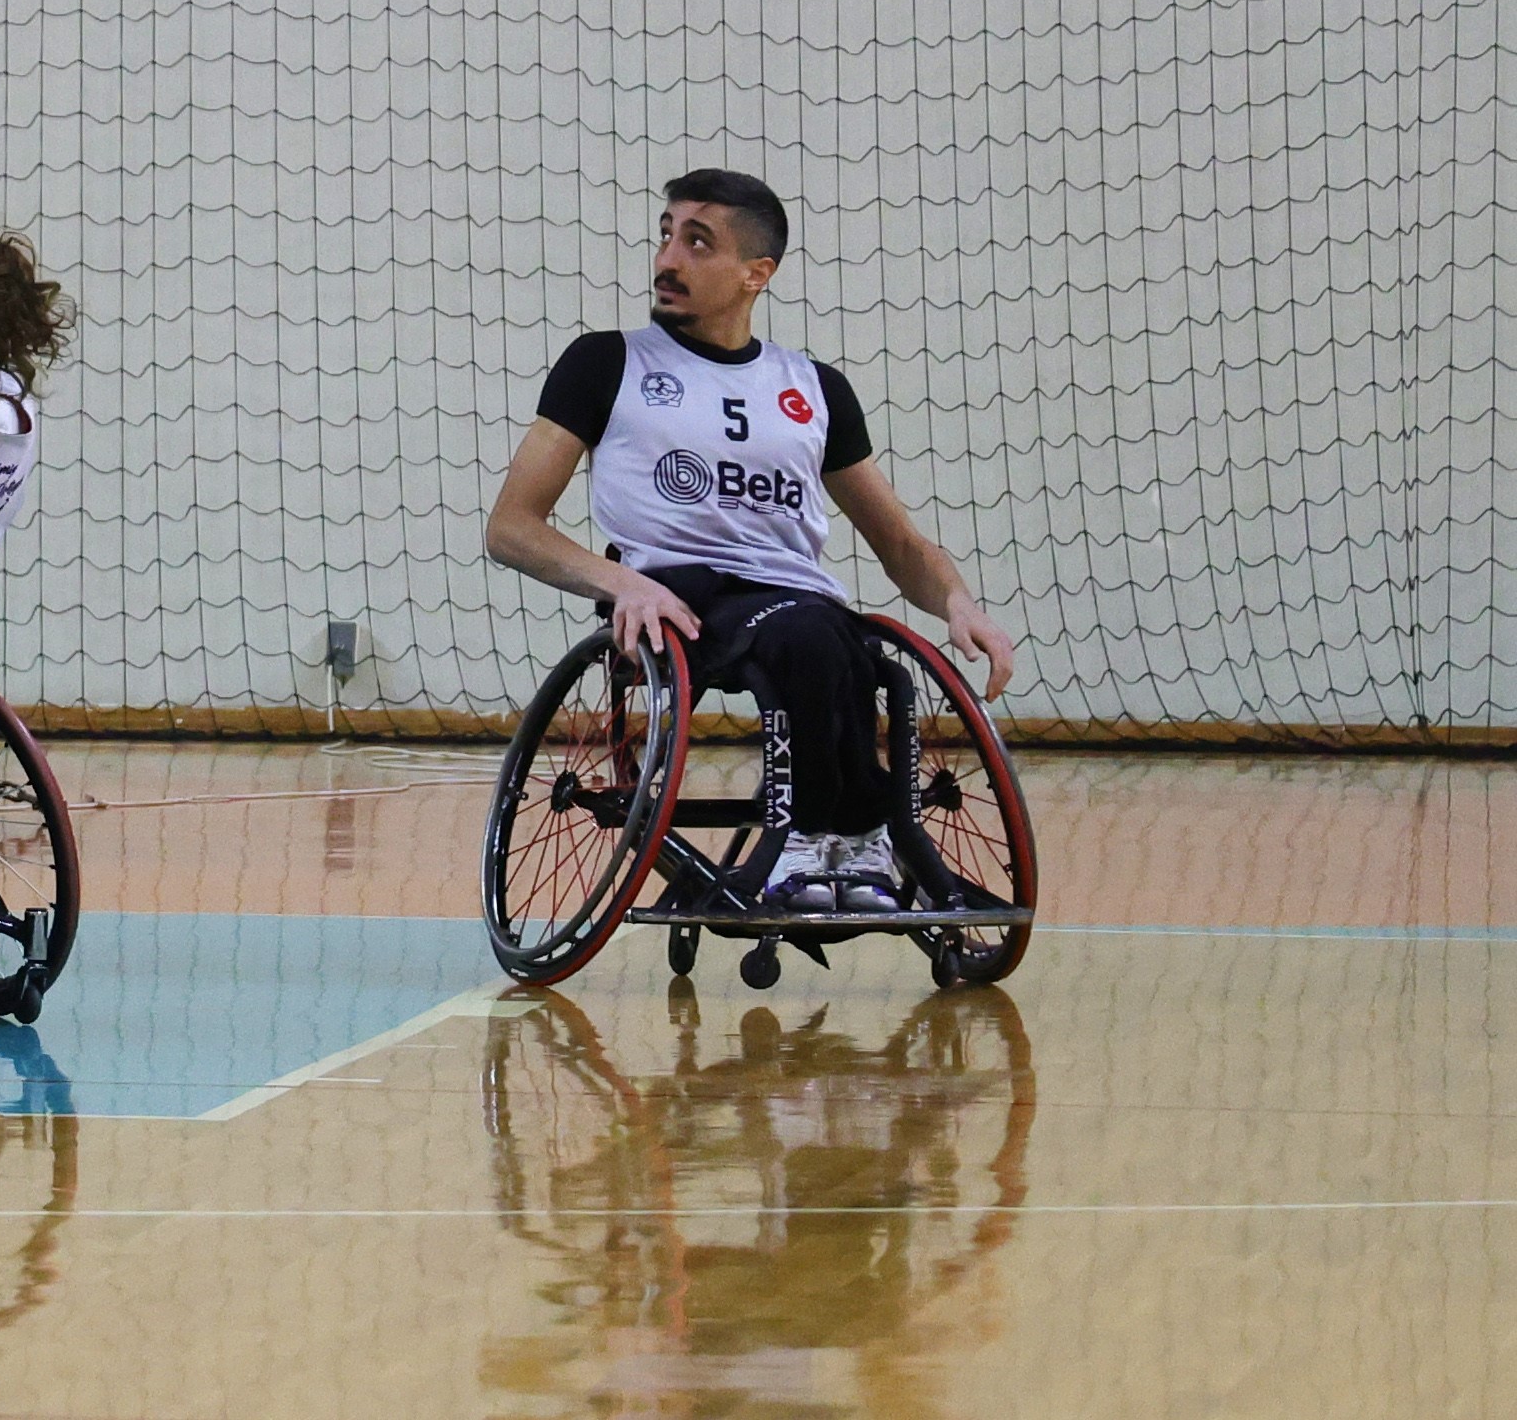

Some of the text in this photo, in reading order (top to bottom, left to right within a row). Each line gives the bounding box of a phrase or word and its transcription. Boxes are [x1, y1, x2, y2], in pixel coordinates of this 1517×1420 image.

[722, 397, 750, 442] 5
[718, 460, 803, 509] Beta
[773, 708, 792, 829] EXTRA
